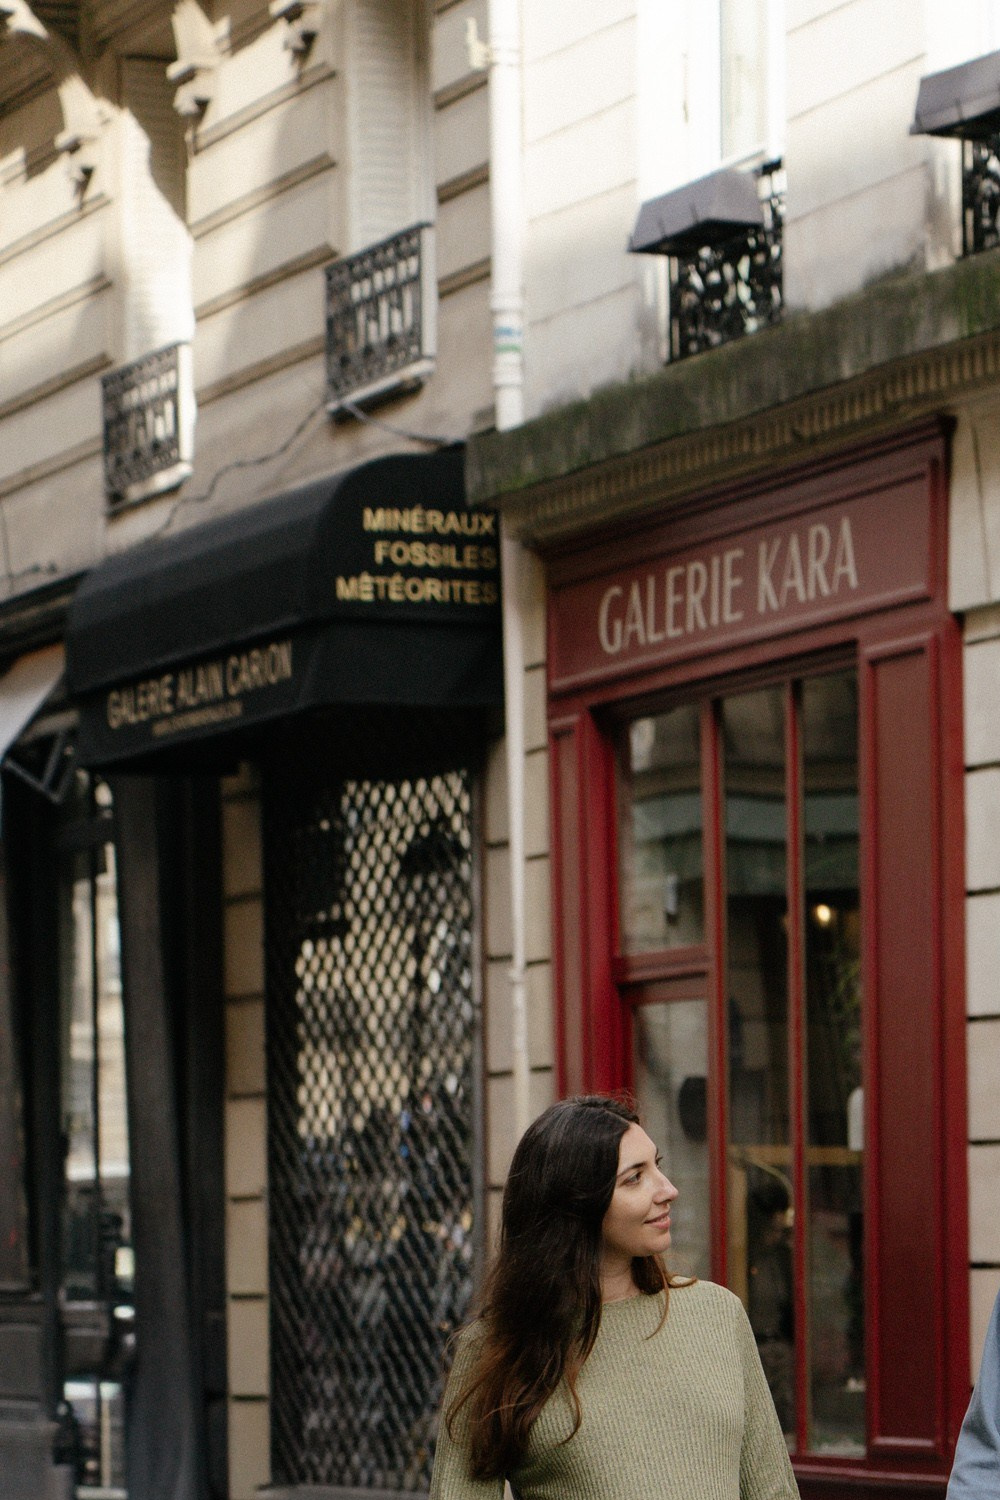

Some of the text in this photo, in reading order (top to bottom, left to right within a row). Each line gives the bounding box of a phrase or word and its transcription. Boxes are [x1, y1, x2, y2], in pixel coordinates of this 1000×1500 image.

[362, 504, 495, 536] MINÉRAUX
[374, 540, 497, 570] FOSSILES
[335, 571, 498, 604] MÉTÉORITES
[598, 516, 859, 655] GALERIE KARA
[107, 673, 174, 730] GALERIE
[177, 662, 224, 706] ALAIN
[226, 640, 292, 696] CARION
